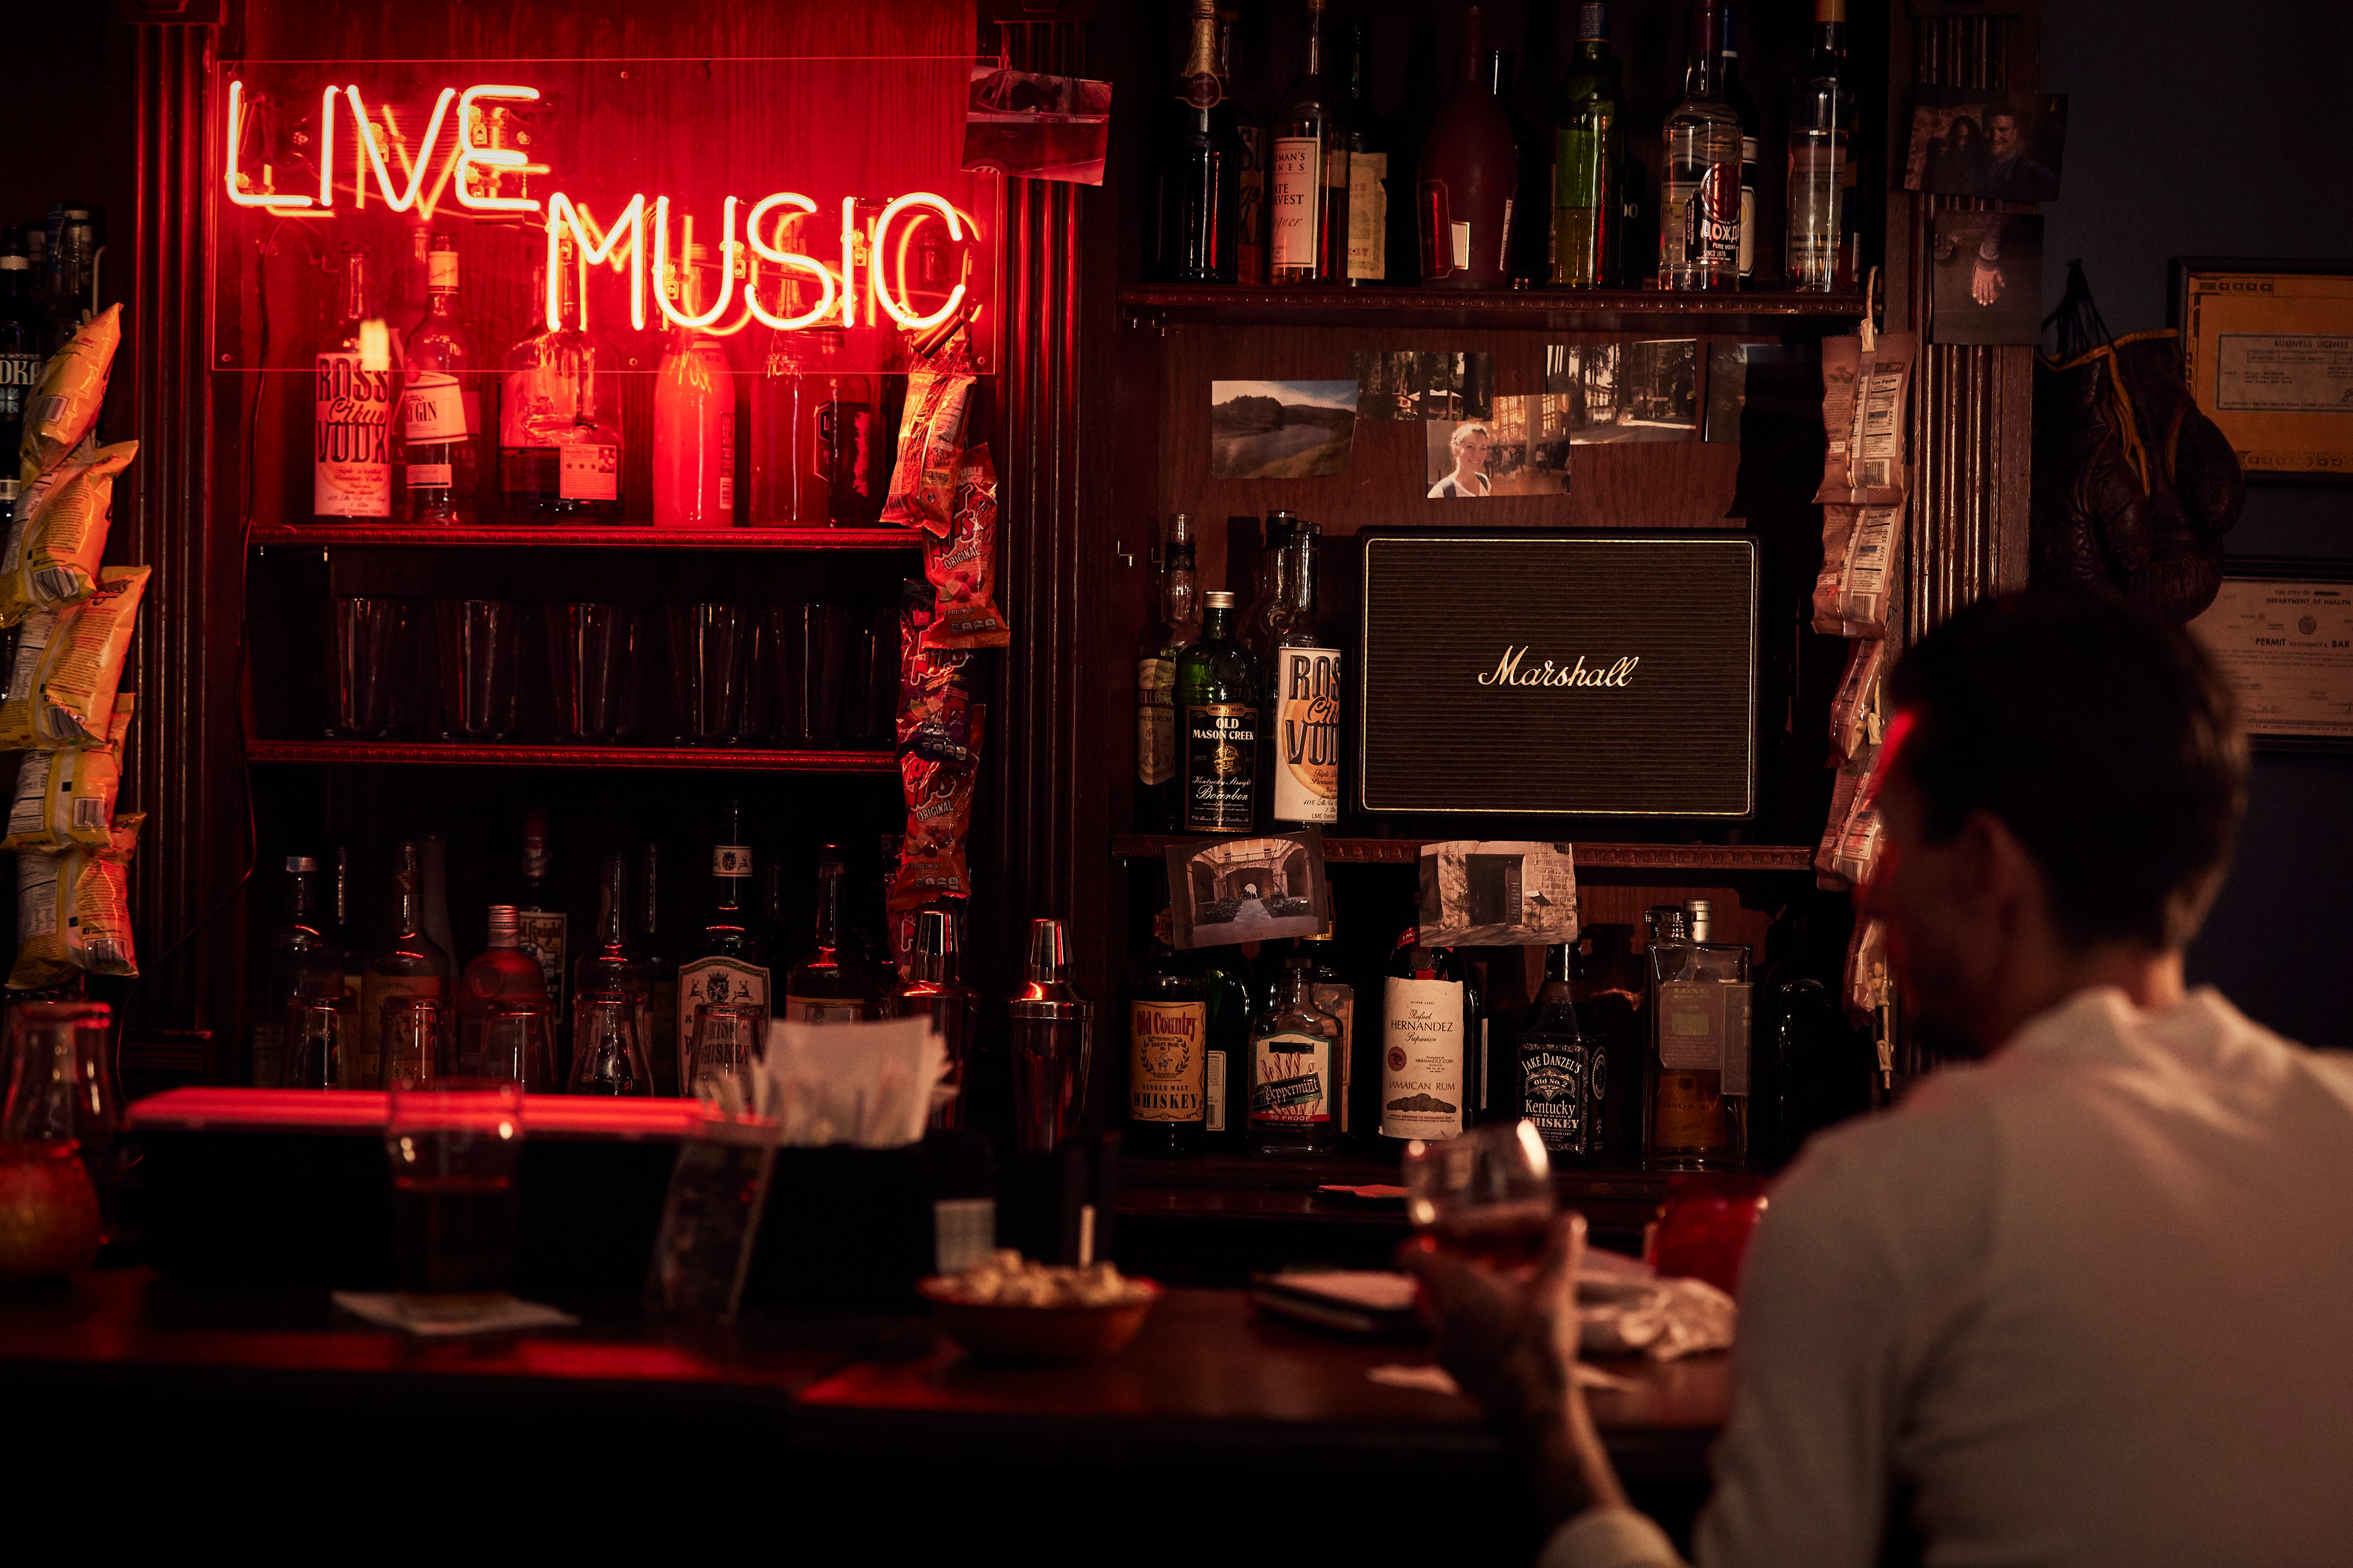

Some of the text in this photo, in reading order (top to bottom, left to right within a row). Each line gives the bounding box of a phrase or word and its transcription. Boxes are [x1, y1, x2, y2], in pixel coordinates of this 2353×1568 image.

[227, 81, 540, 212] LIVE
[1700, 218, 1740, 243] ДОЖД
[547, 192, 966, 331] MUSIC
[2274, 339, 2313, 347] BUSINESS
[318, 358, 388, 402] ROSS
[415, 401, 437, 422] GIN
[961, 466, 983, 476] UBLE
[944, 544, 982, 570] ORIGINAL
[2255, 637, 2286, 646] PERMIT
[2332, 640, 2350, 649] BAR
[1477, 645, 1640, 688] Marshall
[1157, 714, 1172, 723] RUM
[1215, 718, 1240, 729] OLD
[1193, 729, 1254, 741] MASON CREEK
[1192, 776, 1252, 788] Kentucky Straight
[916, 799, 955, 823] ORIGINAL
[1408, 1008, 1433, 1022] Rafael
[1136, 1010, 1197, 1042] Old Country
[1391, 1020, 1453, 1032] HERNANDEZ
[1405, 1032, 1437, 1044] Superior
[1521, 1053, 1583, 1075] JAKE DANZEL'S
[1389, 1080, 1455, 1090] JAMAICAN RUM
[1549, 1077, 1561, 1085] No.
[1263, 1078, 1319, 1105] Peppermint
[1133, 1092, 1198, 1109] WHISKEY
[1525, 1099, 1576, 1119] Kentucky
